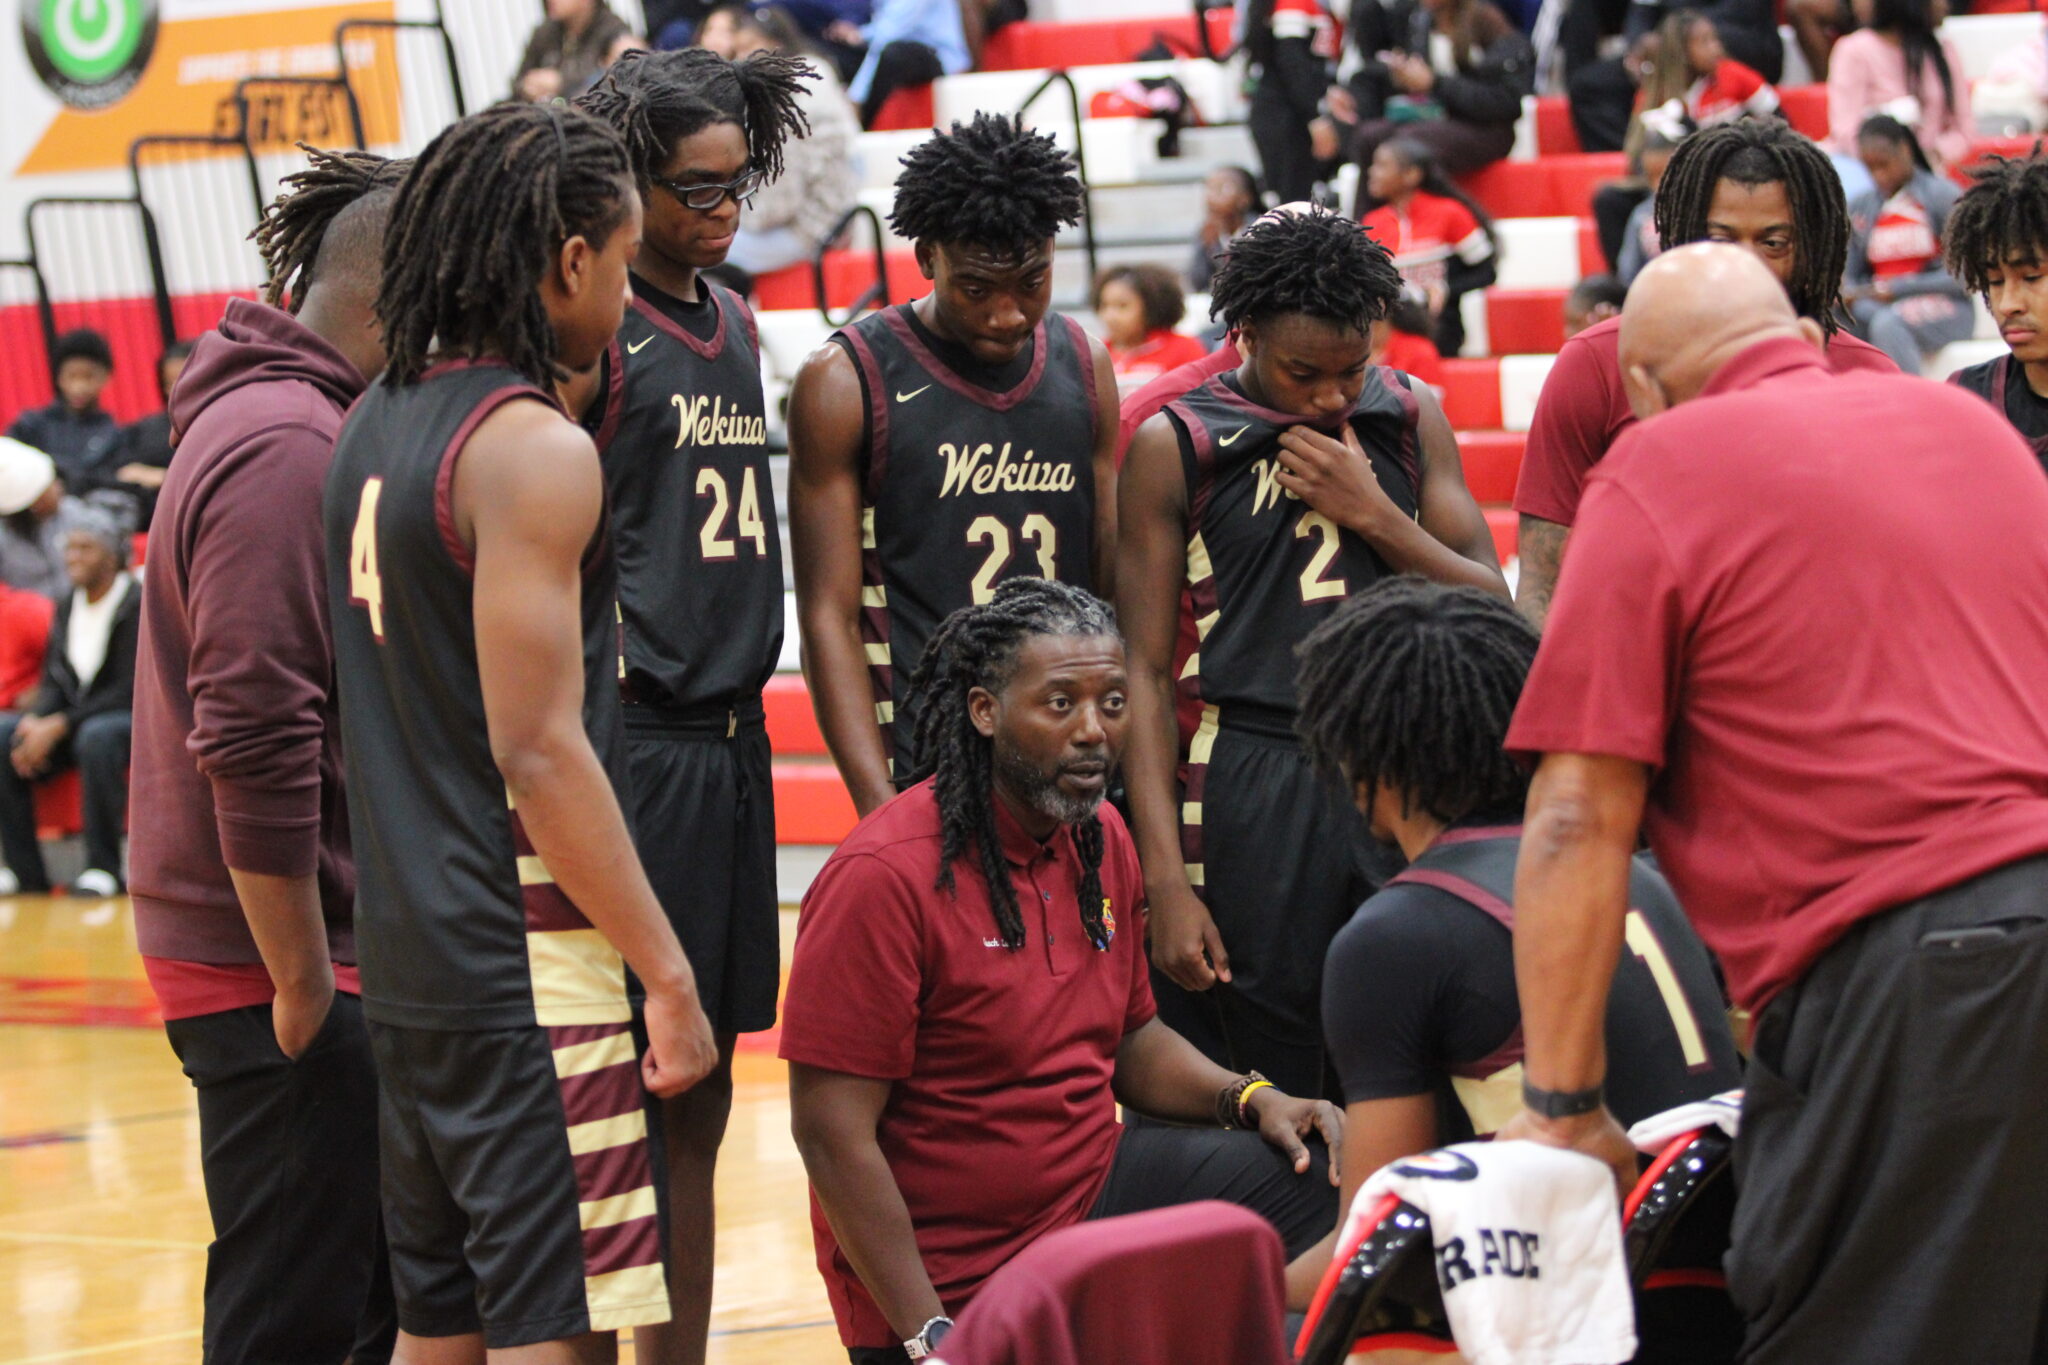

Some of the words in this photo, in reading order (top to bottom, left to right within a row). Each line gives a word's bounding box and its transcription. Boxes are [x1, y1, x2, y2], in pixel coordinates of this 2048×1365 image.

[671, 394, 766, 449] Wekiva
[695, 466, 767, 560] 24
[938, 441, 1075, 498] Wekiva
[349, 477, 385, 640] 4
[966, 513, 1058, 606] 23
[1294, 510, 1347, 604] 2
[1625, 910, 1711, 1071] 1
